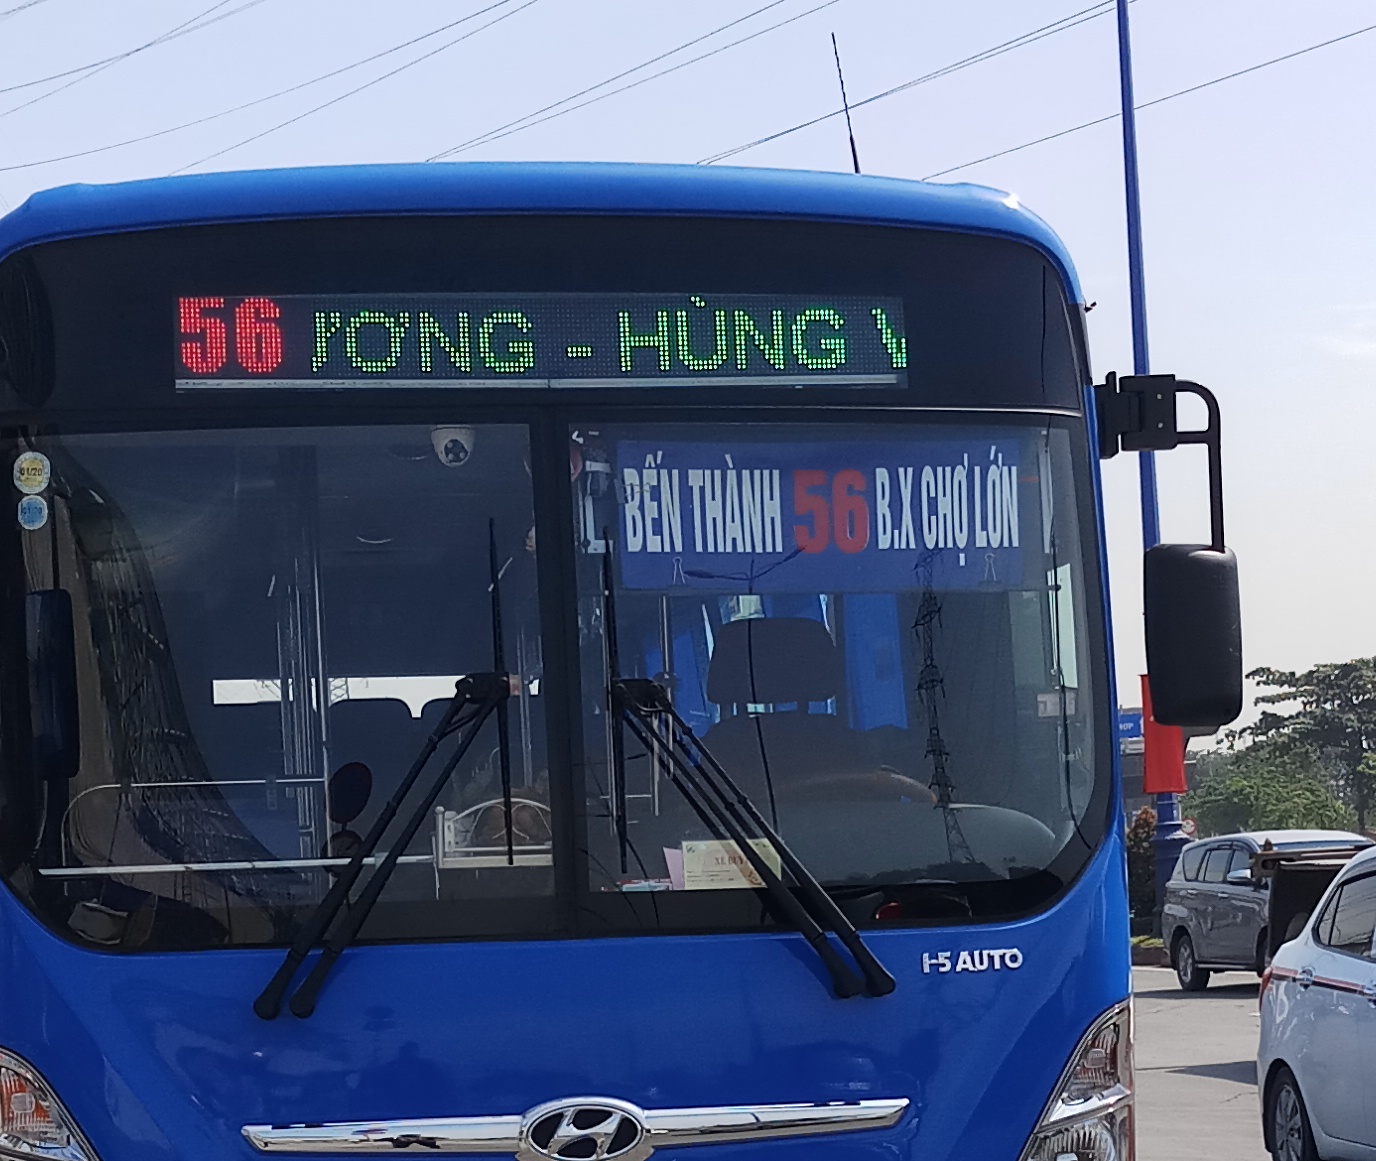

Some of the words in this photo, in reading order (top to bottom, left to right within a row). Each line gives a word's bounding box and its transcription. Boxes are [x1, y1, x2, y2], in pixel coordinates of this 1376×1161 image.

[179, 297, 282, 373] 56
[618, 295, 846, 372] HÙNG
[624, 450, 683, 553] BẾN
[688, 453, 784, 554] THÀNH
[793, 468, 870, 554] 56
[875, 466, 917, 550] B.X
[921, 452, 969, 567] CHỢ
[974, 445, 1020, 549] LỚN
[955, 948, 1023, 972] AUTO
